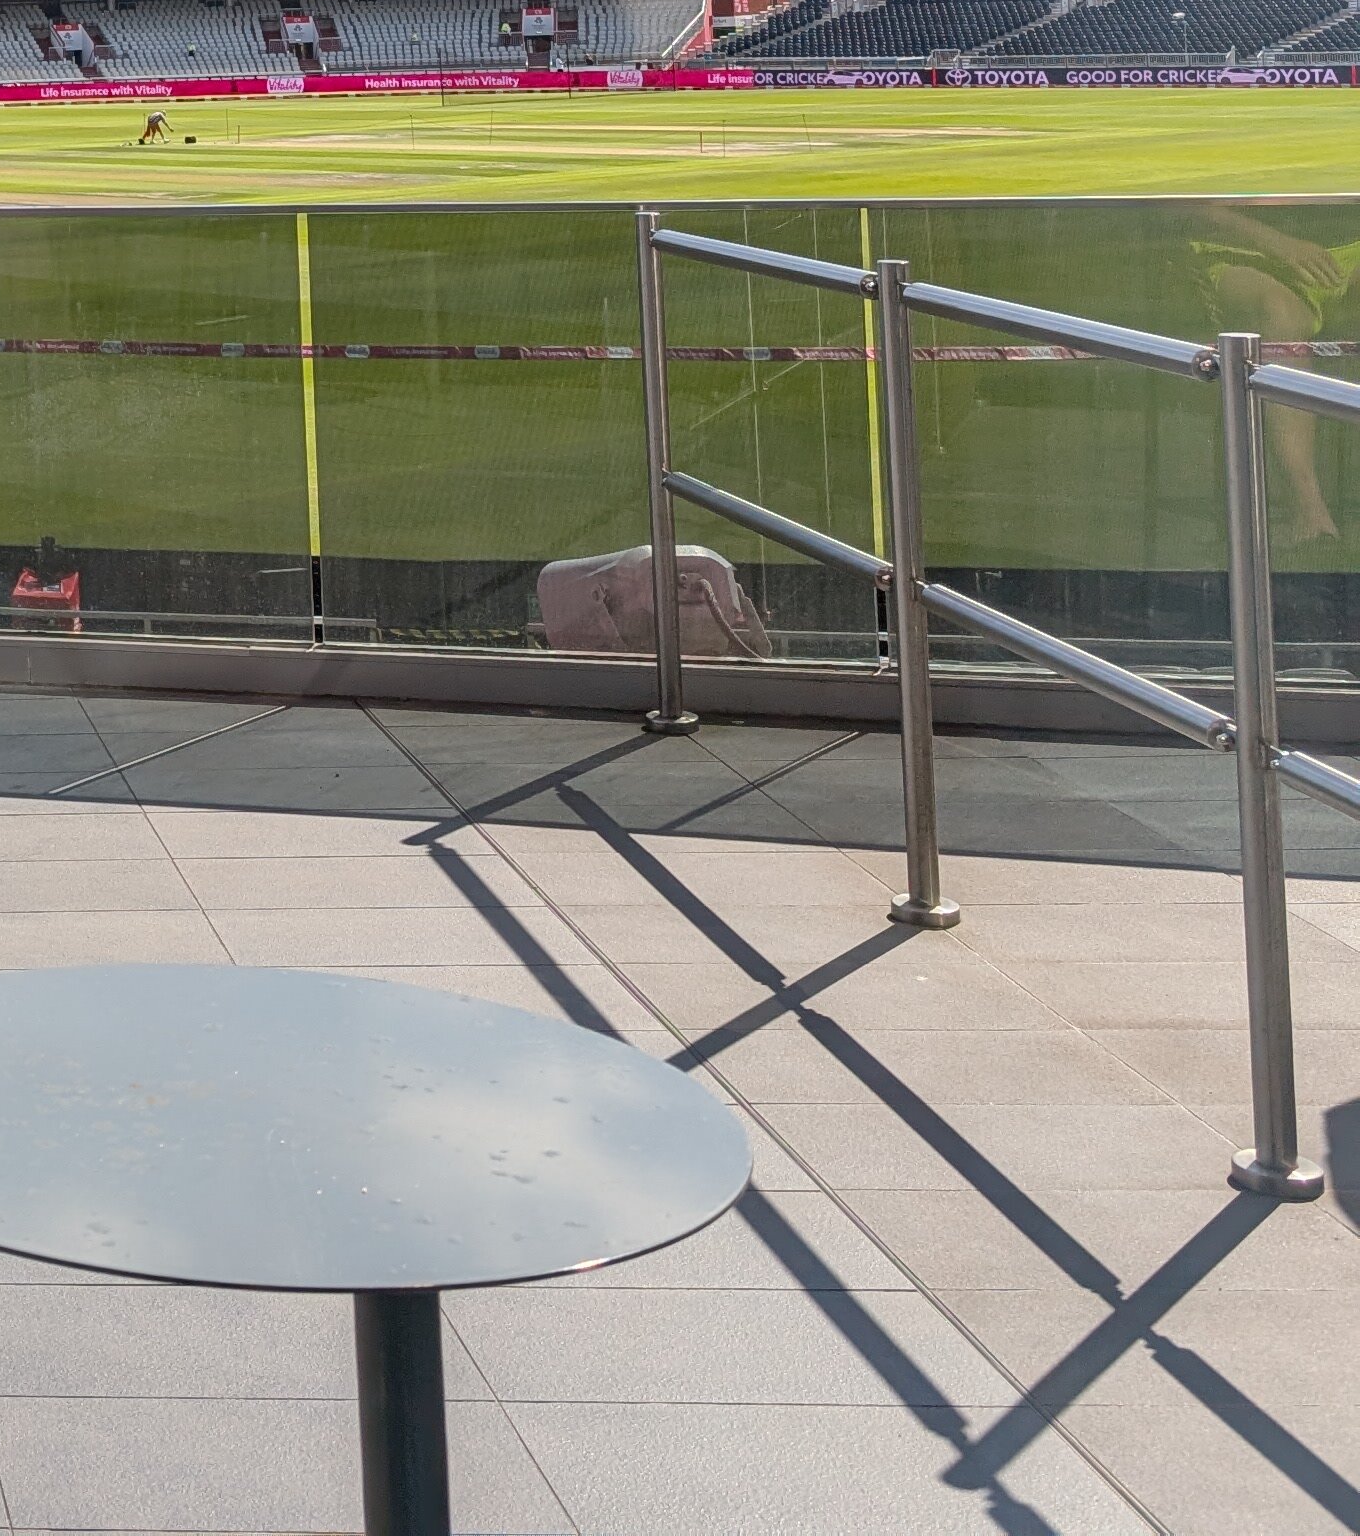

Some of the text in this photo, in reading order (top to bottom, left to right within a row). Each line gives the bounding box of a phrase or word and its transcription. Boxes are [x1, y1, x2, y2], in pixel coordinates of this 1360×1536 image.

[365, 78, 399, 89] Health
[455, 76, 479, 87] with
[481, 75, 520, 88] Vitality
[707, 73, 726, 84] Life
[777, 72, 827, 84] CRICKE
[974, 70, 1050, 85] TOYOTA
[1066, 70, 1222, 84] GOOD FOR CRICKE
[41, 86, 59, 97] Life
[110, 85, 133, 96] with
[134, 84, 173, 96] Vitality
